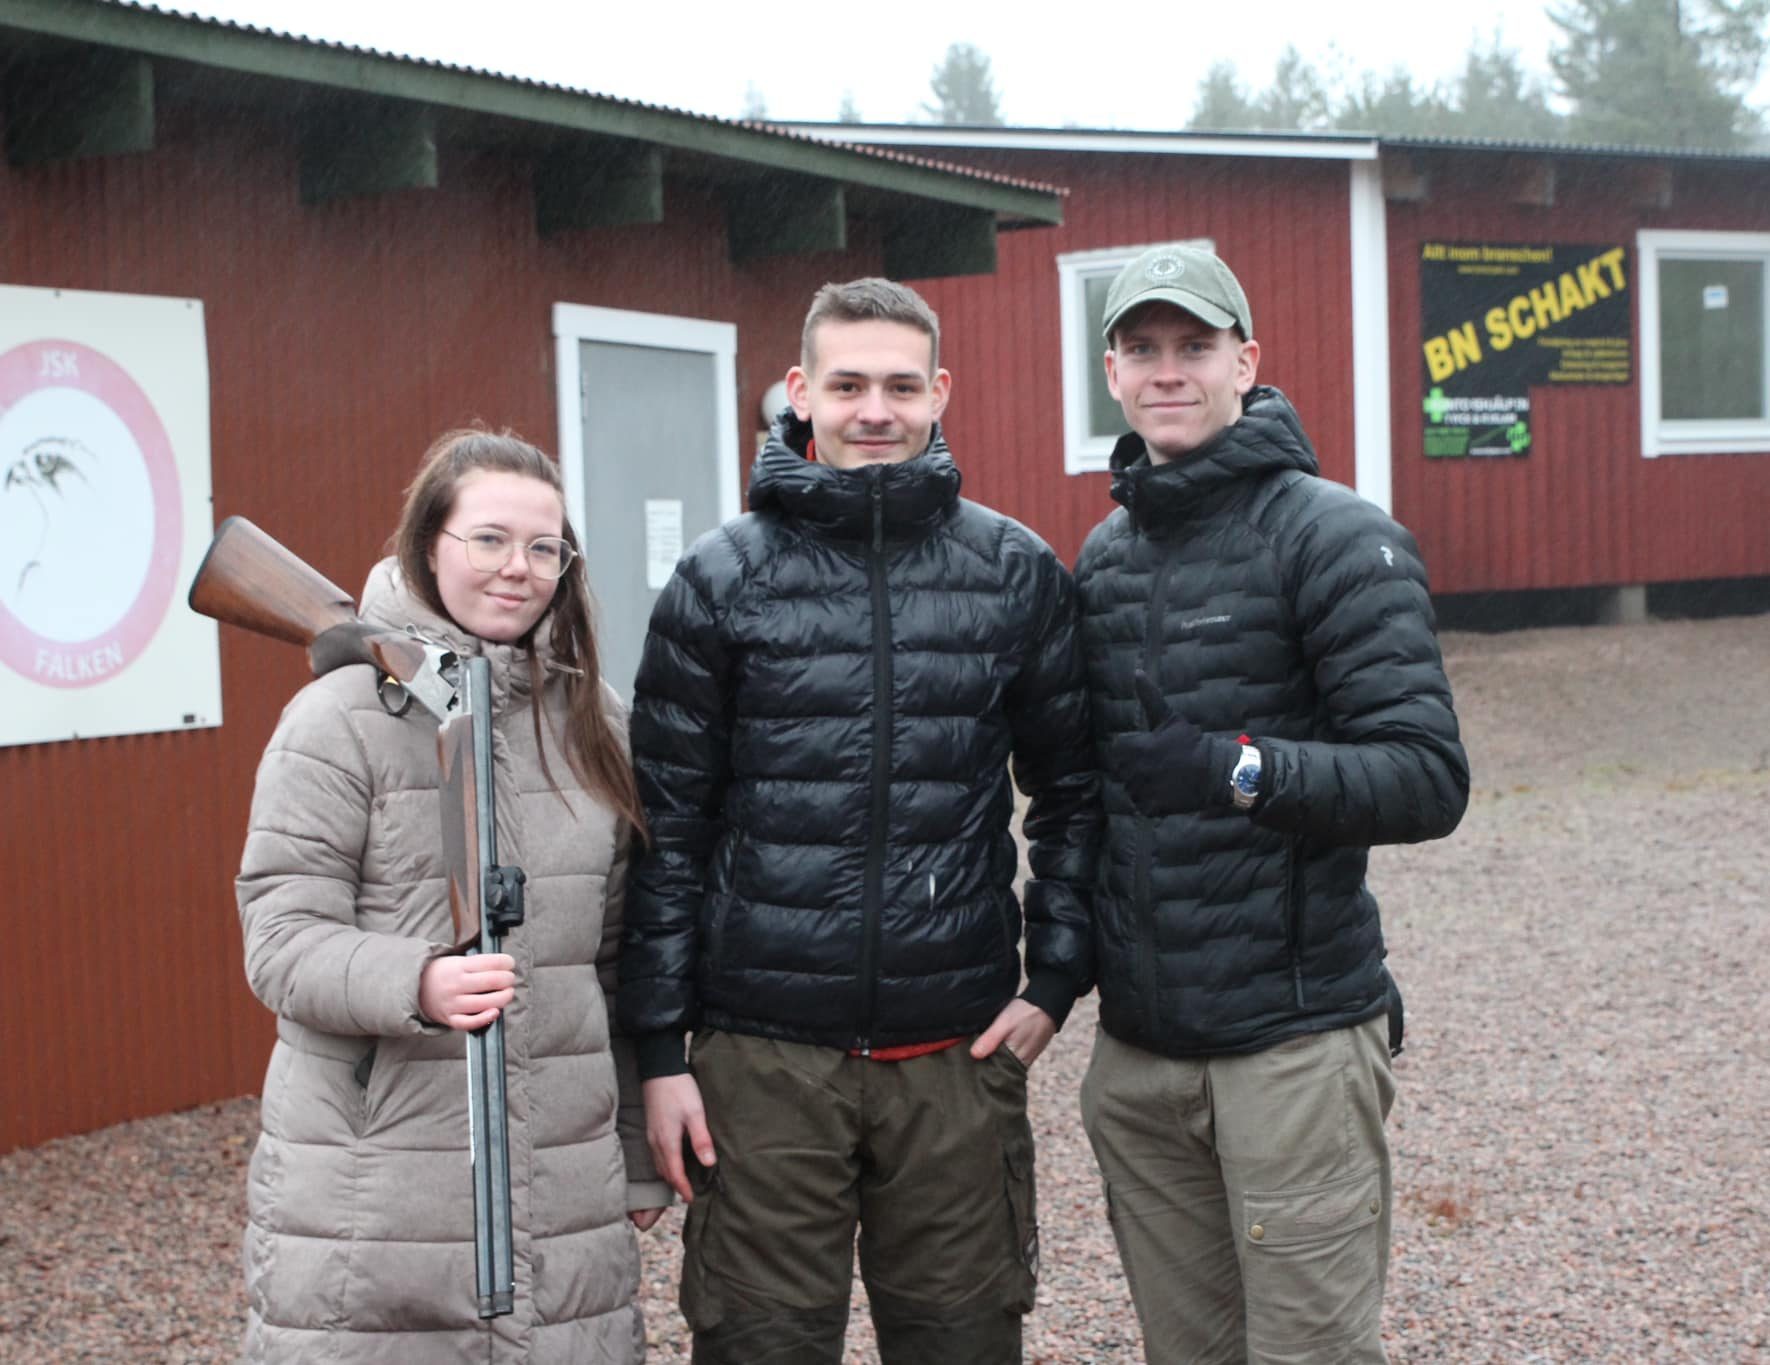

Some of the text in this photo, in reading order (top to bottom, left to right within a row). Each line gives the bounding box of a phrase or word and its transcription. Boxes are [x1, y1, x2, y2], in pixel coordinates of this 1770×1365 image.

[1423, 247, 1626, 383] BN SCHAKT
[38, 348, 81, 378] JSK
[34, 640, 123, 680] FALKEN
